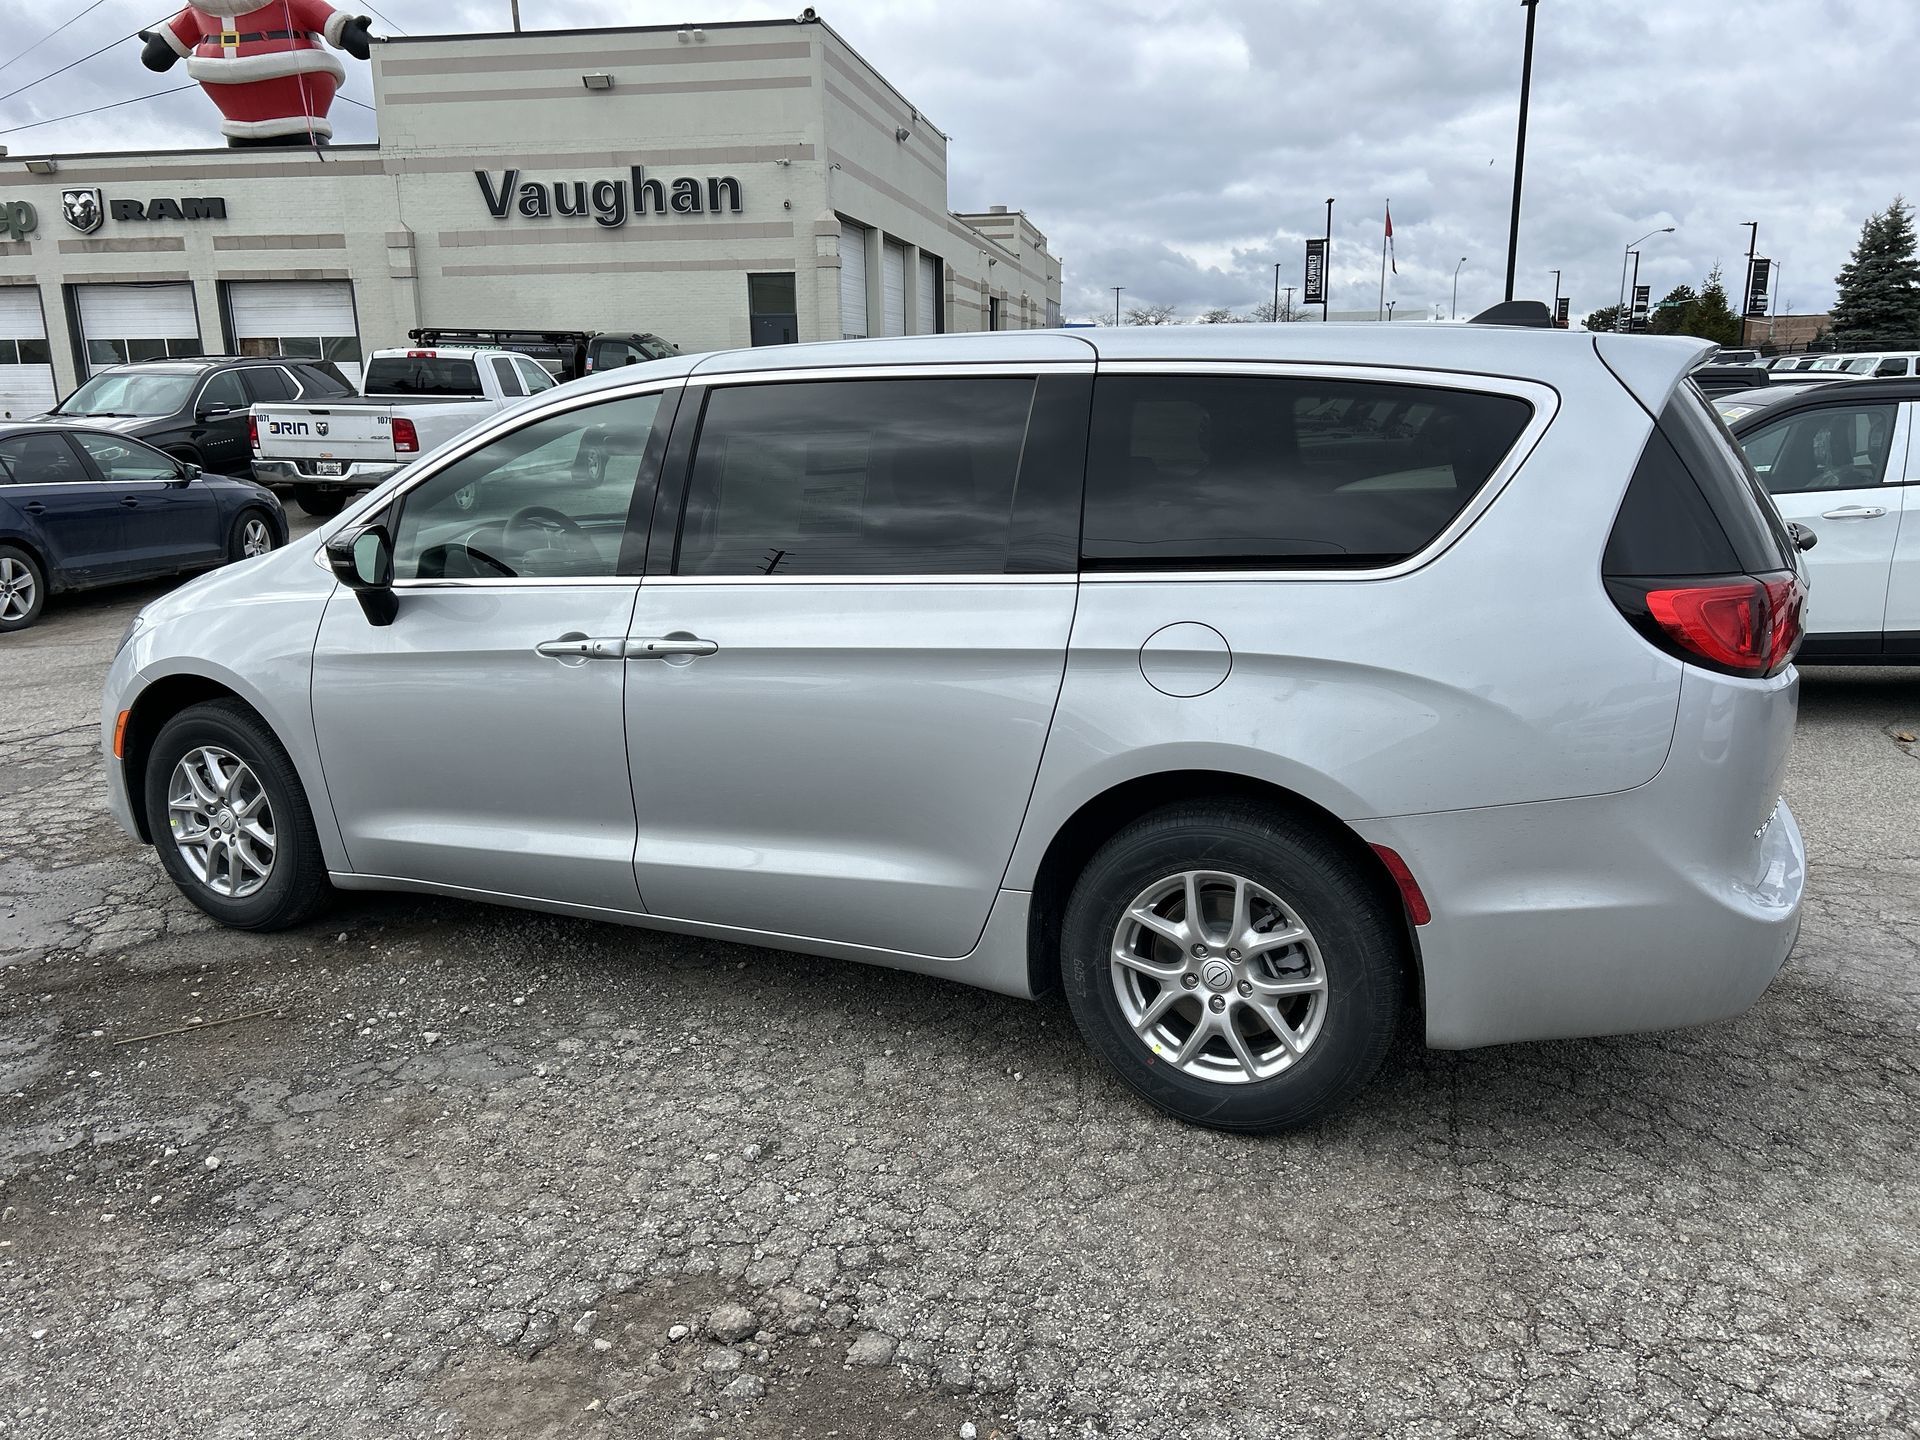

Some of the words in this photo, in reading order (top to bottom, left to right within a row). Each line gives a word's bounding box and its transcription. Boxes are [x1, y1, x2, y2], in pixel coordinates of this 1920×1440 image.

[110, 197, 227, 220] RAM
[475, 166, 743, 228] Vaughan
[1307, 255, 1317, 295] PRE-OWNED
[377, 417, 392, 425] 1071
